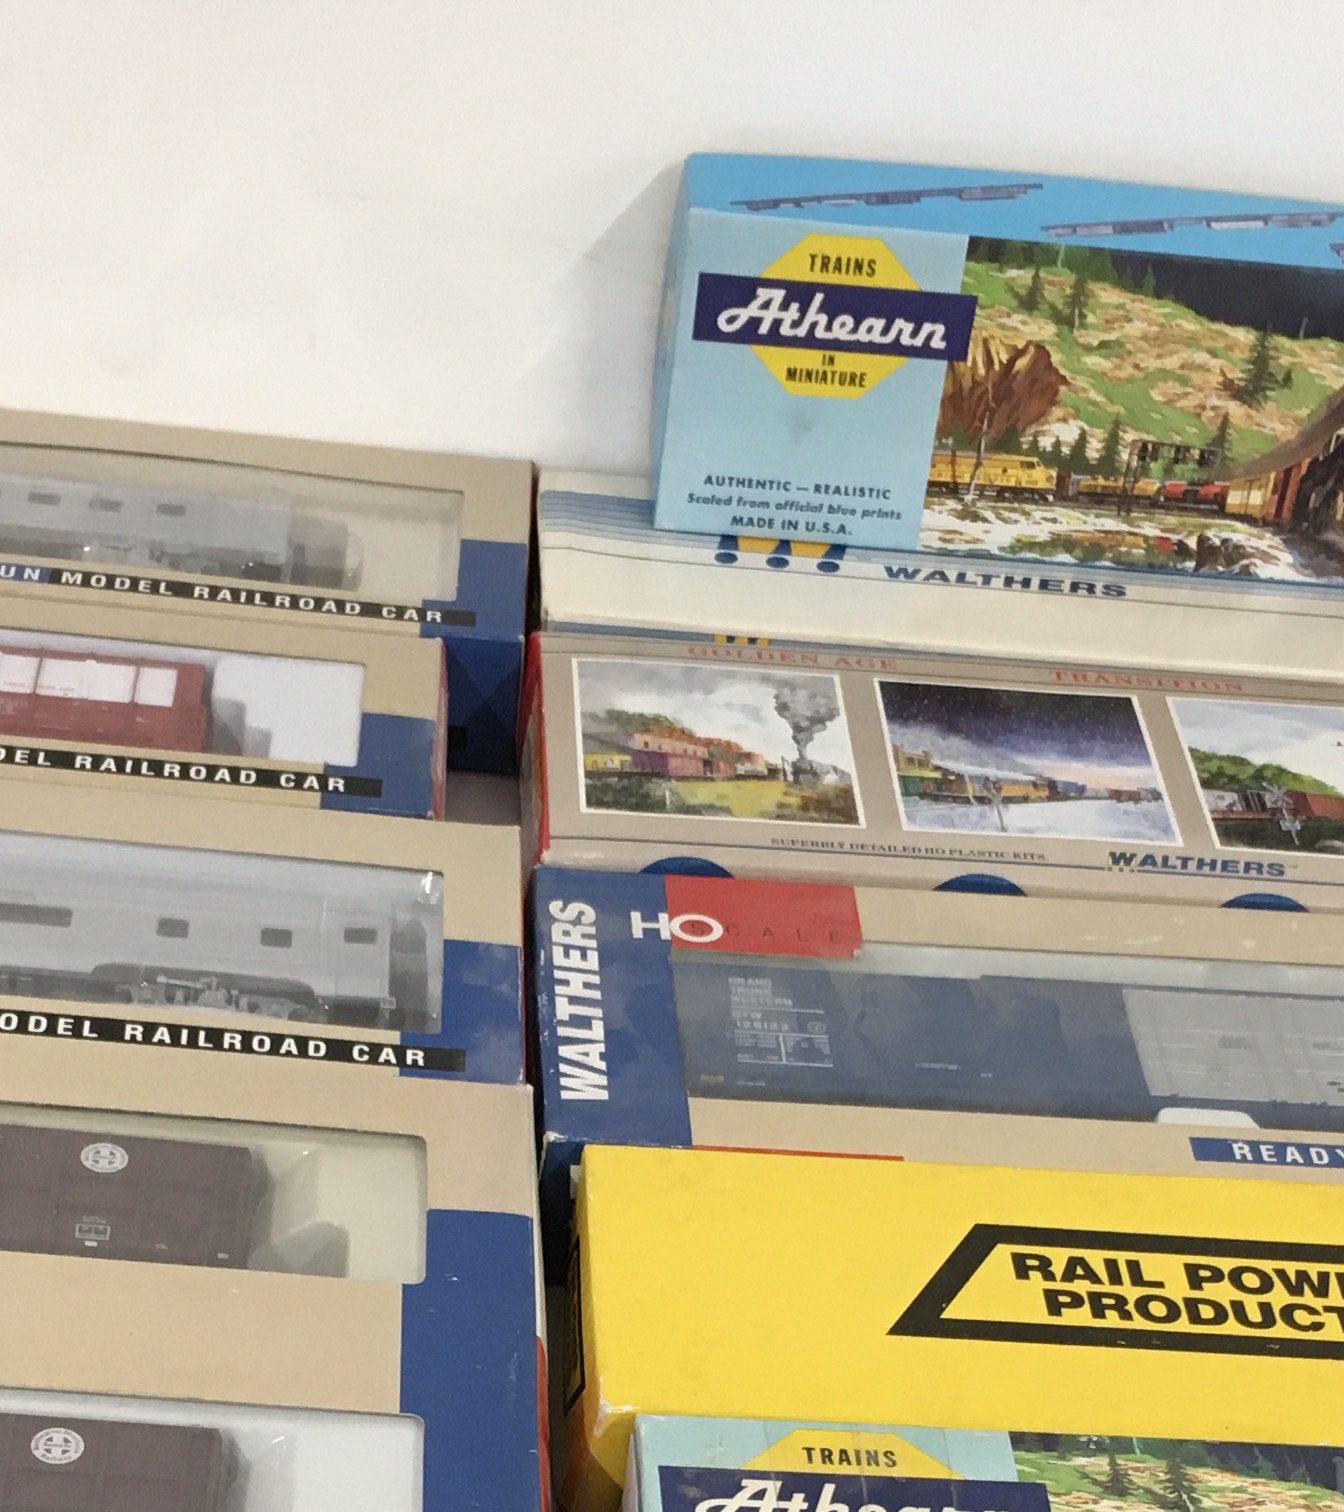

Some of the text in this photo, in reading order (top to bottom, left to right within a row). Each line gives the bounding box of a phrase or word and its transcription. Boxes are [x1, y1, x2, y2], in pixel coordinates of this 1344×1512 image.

[808, 253, 877, 279] TRAINS
[717, 287, 947, 351] Athearn
[821, 353, 836, 366] IN
[785, 367, 867, 389] MINIATURE
[704, 474, 892, 501] AUTHENTIC REALISTIC
[686, 492, 903, 521] Scaled from official blue prints
[730, 515, 853, 536] MADE IN U.S.A.
[59, 570, 173, 596] MODEL
[194, 582, 363, 616] RAILROAD
[380, 604, 444, 624] CAR
[883, 564, 1128, 598] WALTHERS
[686, 646, 820, 668] GOLDEN
[834, 656, 899, 671] AGE
[1048, 670, 1246, 693] TRANSITION
[73, 753, 260, 786] RAILROAD
[277, 771, 349, 793] CAR
[1107, 850, 1287, 878] WALTHERS
[630, 911, 724, 943] HO
[548, 899, 610, 1101] WALTHERS
[123, 1022, 331, 1059] RAILROAD
[350, 1042, 428, 1068] CAR
[1009, 1250, 1166, 1292] RAIL
[801, 1445, 898, 1469] TRAINS
